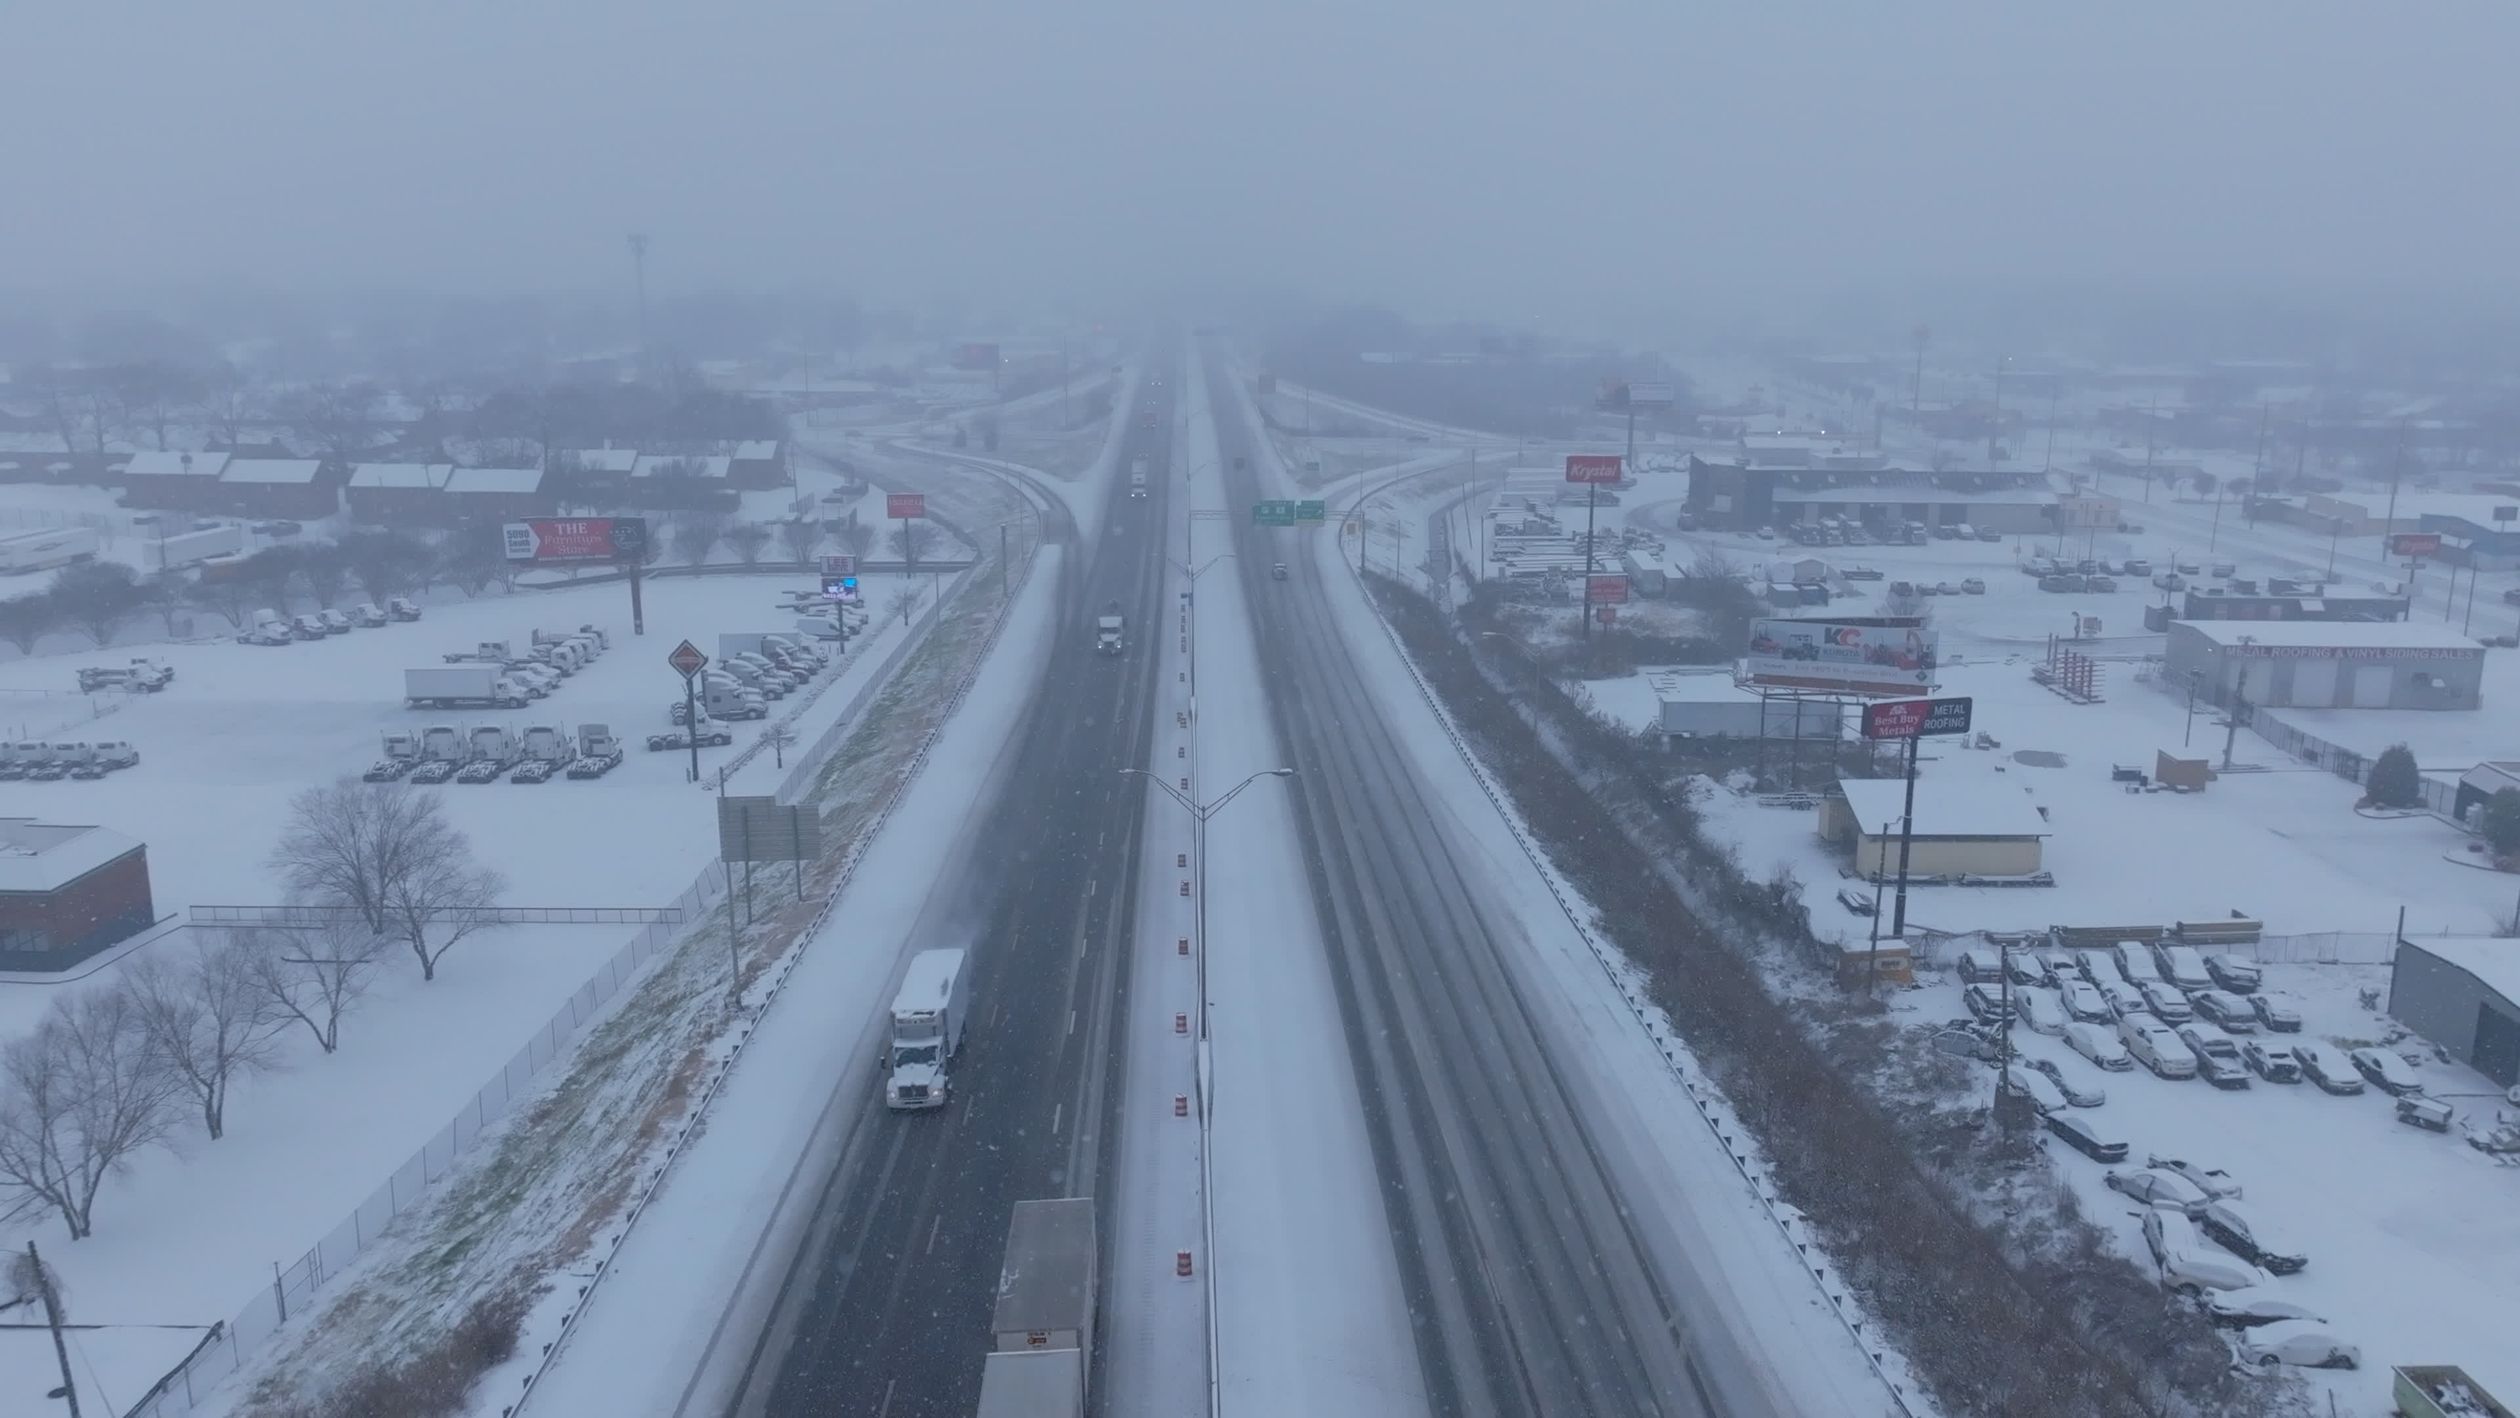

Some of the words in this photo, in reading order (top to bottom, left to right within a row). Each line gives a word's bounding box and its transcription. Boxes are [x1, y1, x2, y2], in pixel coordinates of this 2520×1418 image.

[1570, 463, 1617, 480] Krystal
[555, 522, 588, 535] THE
[1824, 626, 1862, 648] KC
[2226, 647, 2268, 657] MEAL
[2271, 647, 2331, 657] ROOFING
[2347, 648, 2384, 657] VINYL
[2385, 648, 2431, 659] SIDING
[2430, 649, 2474, 660] SALES
[1934, 704, 1965, 716] METAL
[1874, 716, 1897, 726] Best
[1899, 714, 1920, 725] Buy
[1923, 717, 1965, 729] ROOFING
[1879, 725, 1915, 737] Metals
